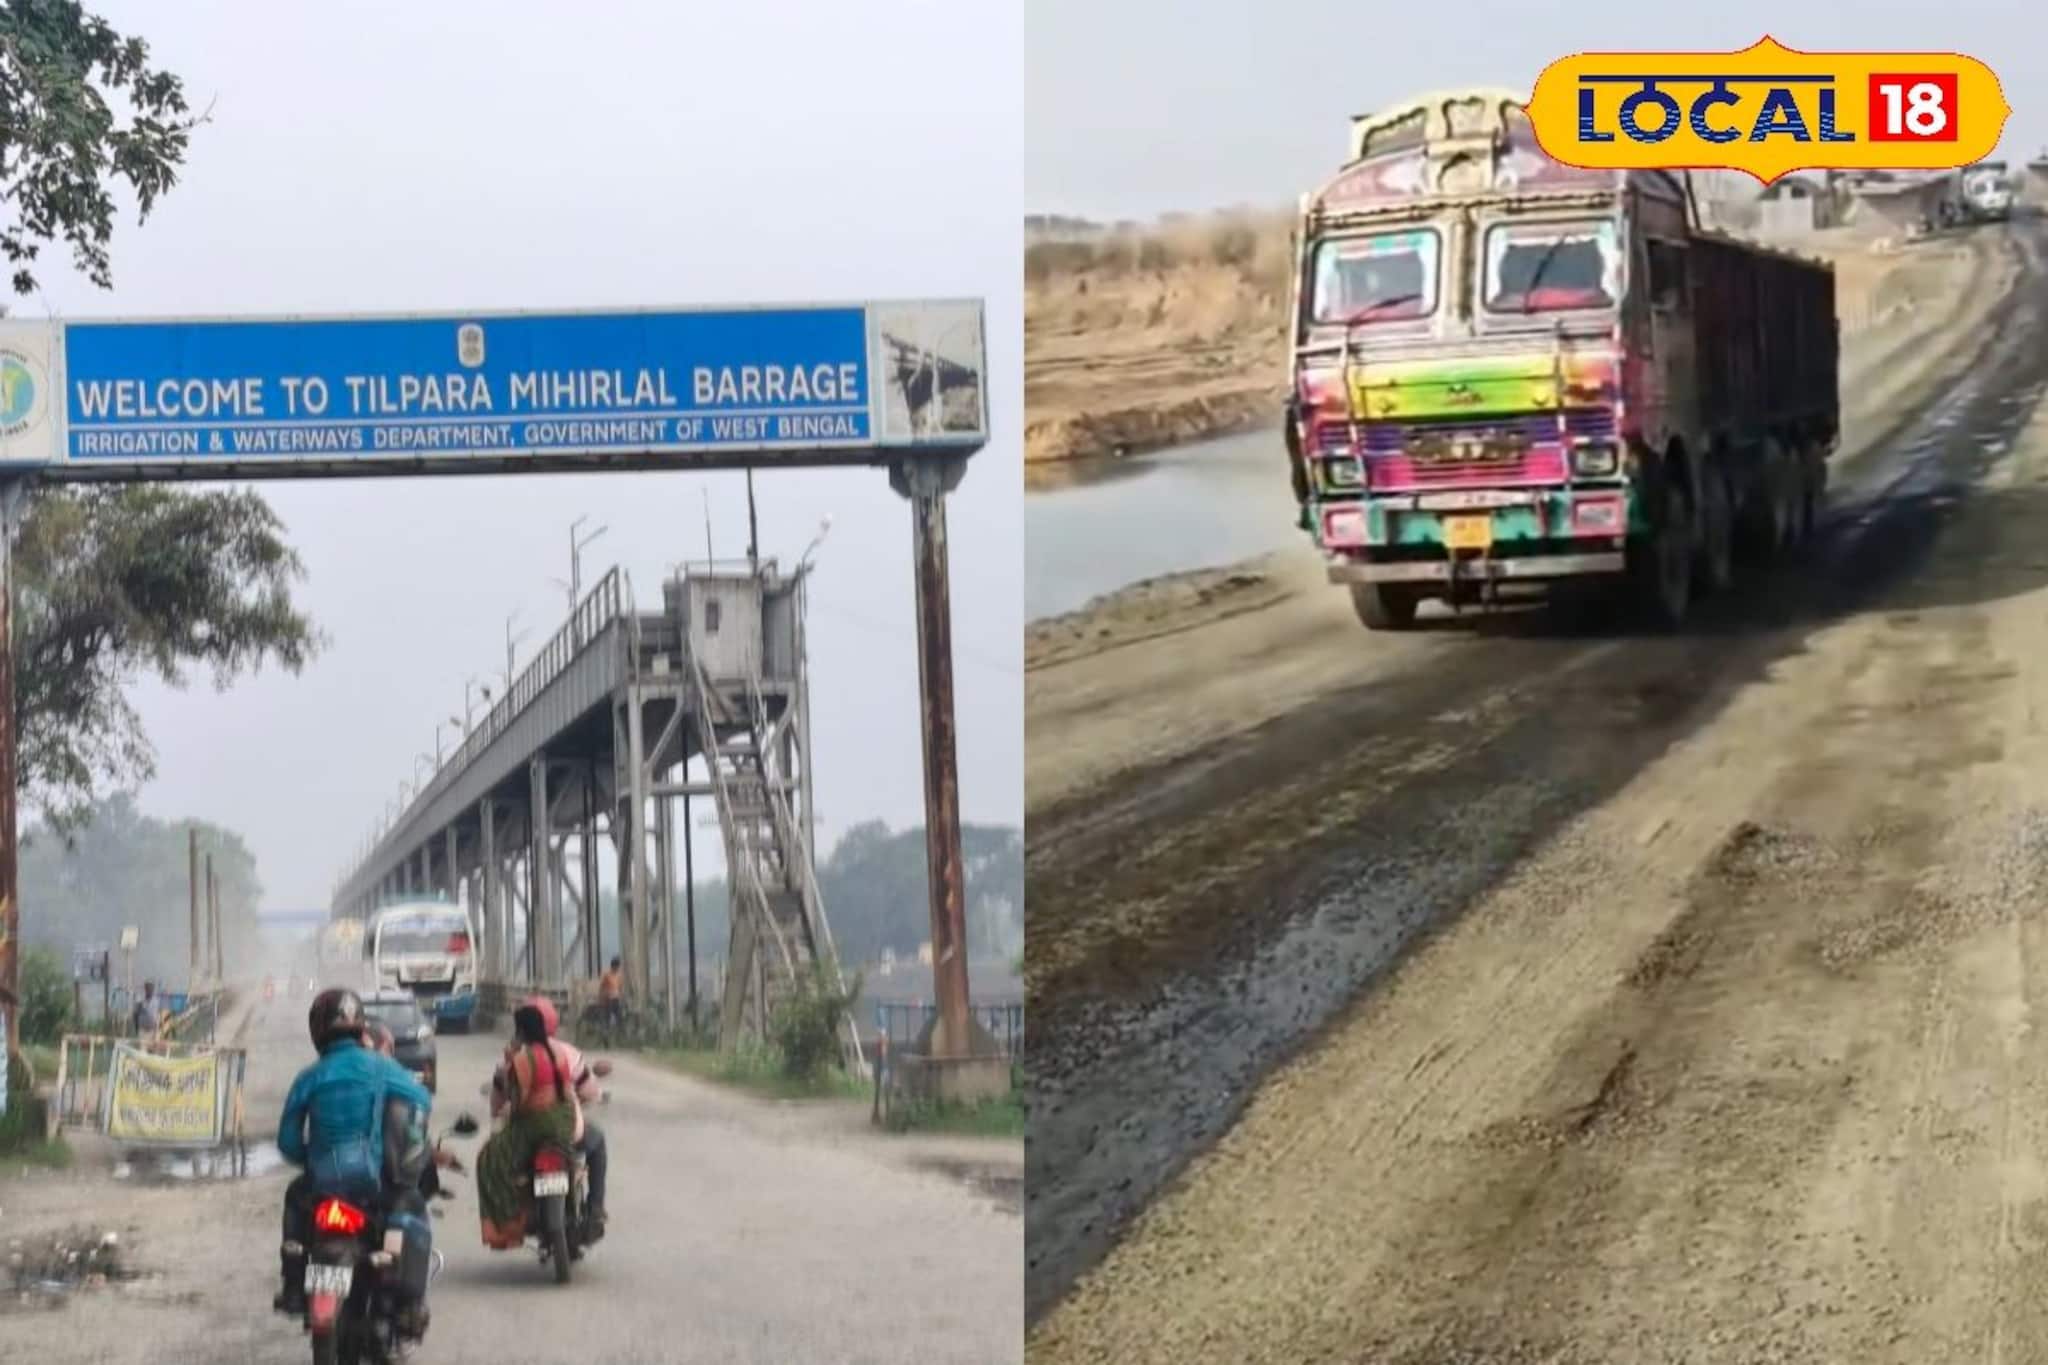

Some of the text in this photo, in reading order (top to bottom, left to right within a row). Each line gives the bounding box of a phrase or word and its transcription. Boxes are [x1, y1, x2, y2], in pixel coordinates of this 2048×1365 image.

[77, 363, 860, 417] WELCOME TO TILPARA MIHIRLAL BARRAGE
[78, 415, 859, 452] IRRIGATION & WATERWAYS DEPARTMENT, GOVERNMENT OF WEST BENGAL
